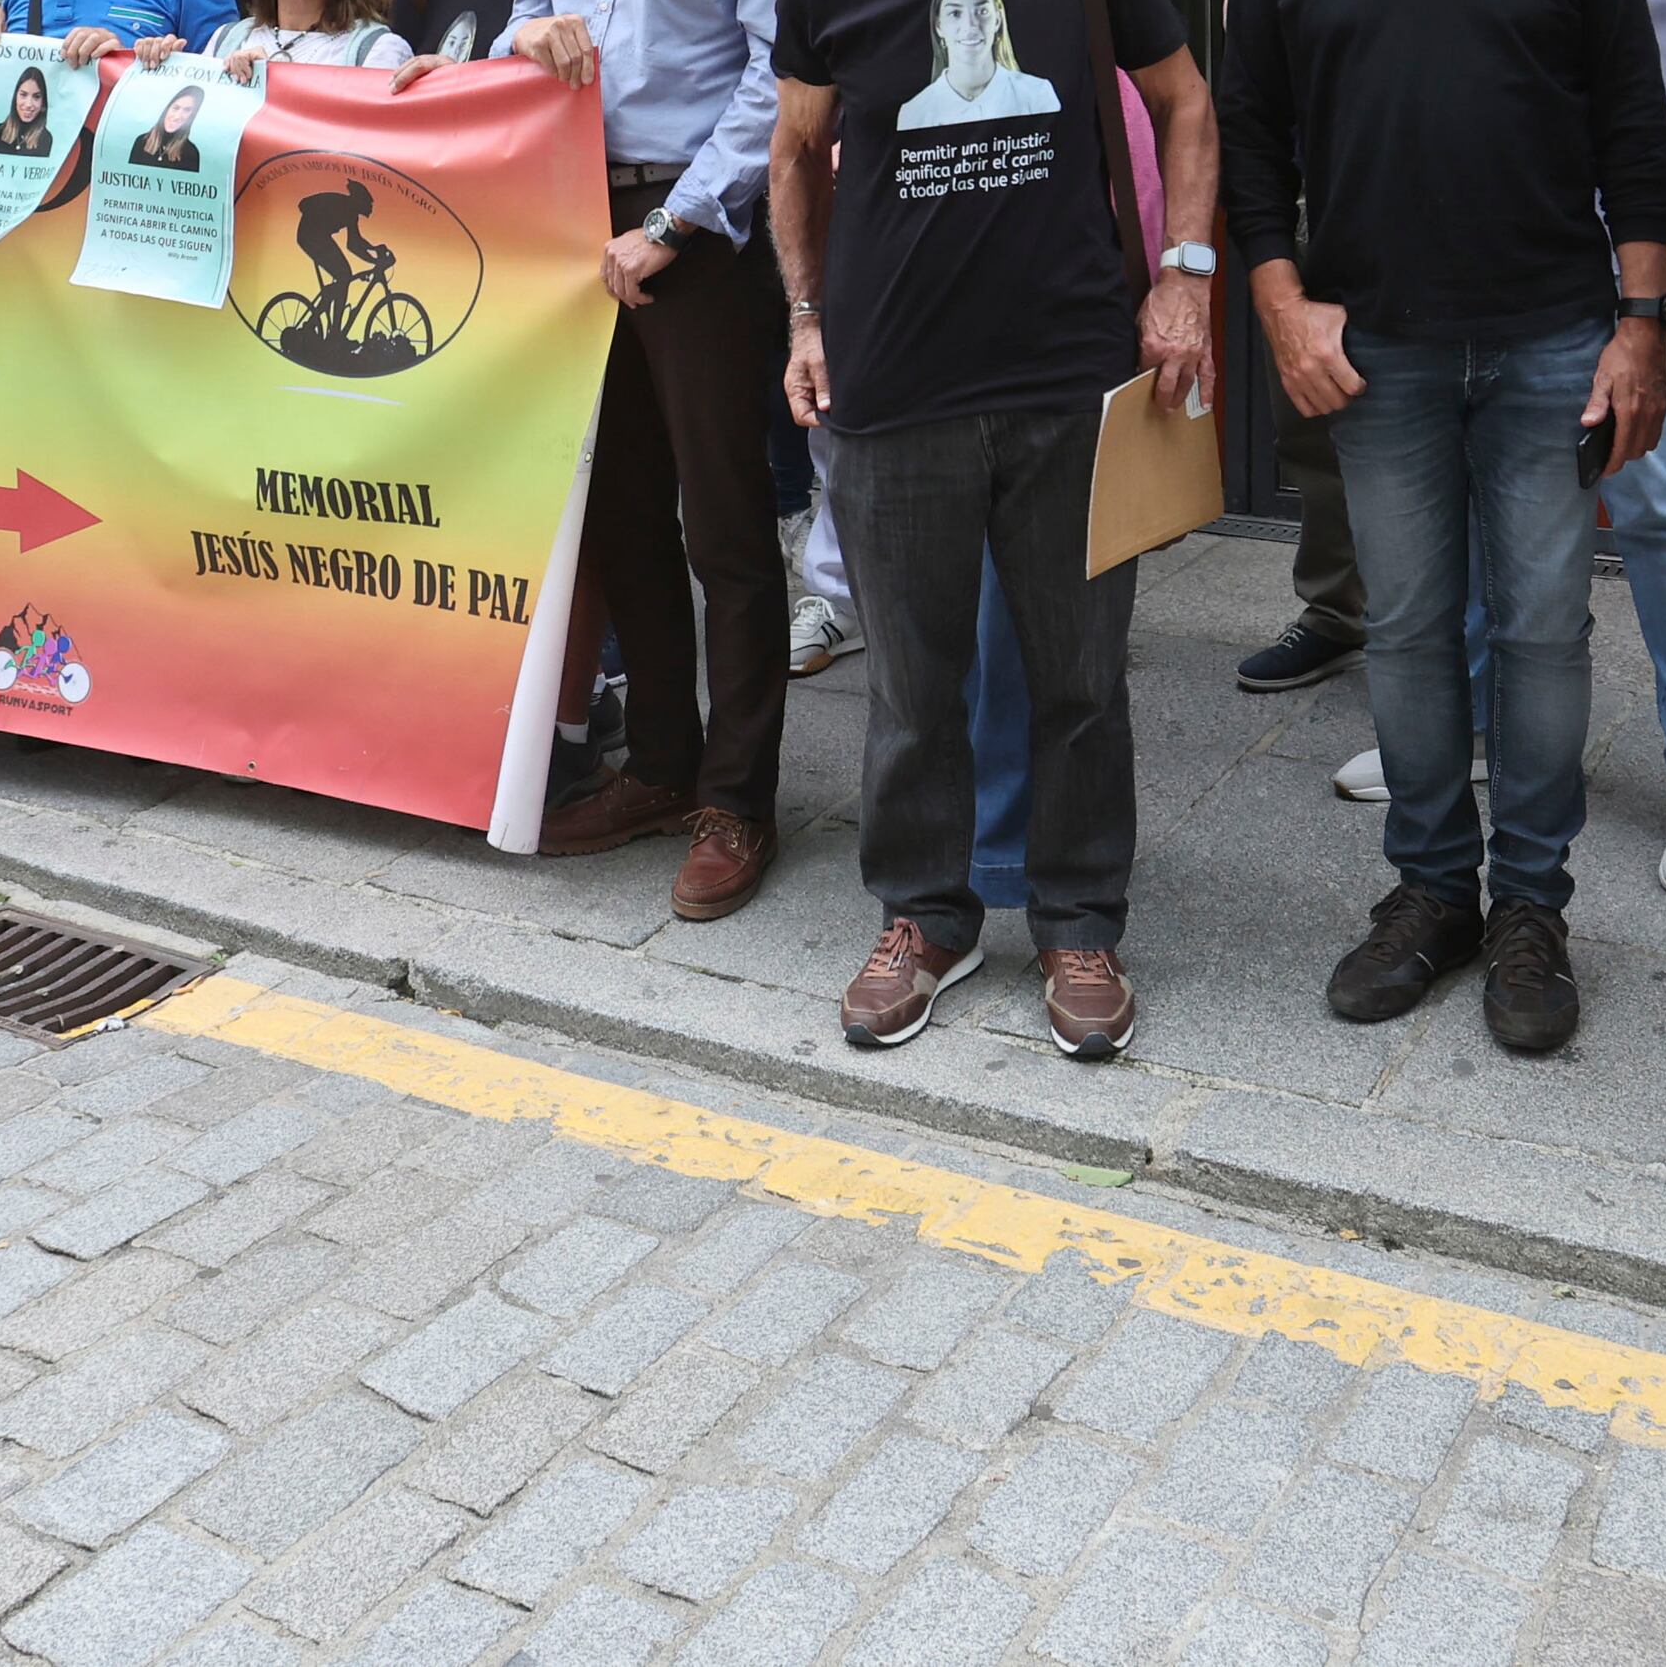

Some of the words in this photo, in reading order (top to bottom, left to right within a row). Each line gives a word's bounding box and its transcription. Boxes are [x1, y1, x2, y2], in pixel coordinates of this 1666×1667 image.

[18, 46, 44, 62] CON
[184, 67, 215, 83] CON
[901, 144, 957, 163] Permitir
[962, 142, 988, 156] una
[11, 165, 17, 178] Y
[896, 164, 950, 184] significa
[954, 159, 988, 175] abrir
[993, 155, 1006, 170] el
[98, 171, 151, 188] JUSTICIA
[157, 178, 164, 192] Y
[171, 181, 217, 199] VERDAD
[362, 168, 393, 188] JESÚS
[397, 184, 438, 215] NEGRO
[899, 188, 908, 199] a
[911, 183, 949, 198] todas
[952, 177, 974, 192] las
[979, 175, 1008, 192] que
[104, 199, 143, 212] PERMITIR
[146, 204, 165, 215] UNA
[168, 207, 214, 222] INJUSTICIA
[96, 212, 138, 227] SIGNIFICA
[140, 219, 166, 230] ABRIR
[169, 223, 179, 232] EL
[181, 224, 217, 238] CAMINO
[101, 229, 107, 238] A
[110, 230, 138, 242] TODAS
[141, 234, 156, 244] LAS
[158, 237, 177, 249] QUE
[179, 240, 212, 253] SIGUEN
[256, 467, 440, 528] MEMORIAL
[191, 530, 279, 581] JESÚS
[285, 543, 401, 600] NEGRO
[413, 559, 456, 612] DE
[468, 569, 530, 625] PAZ
